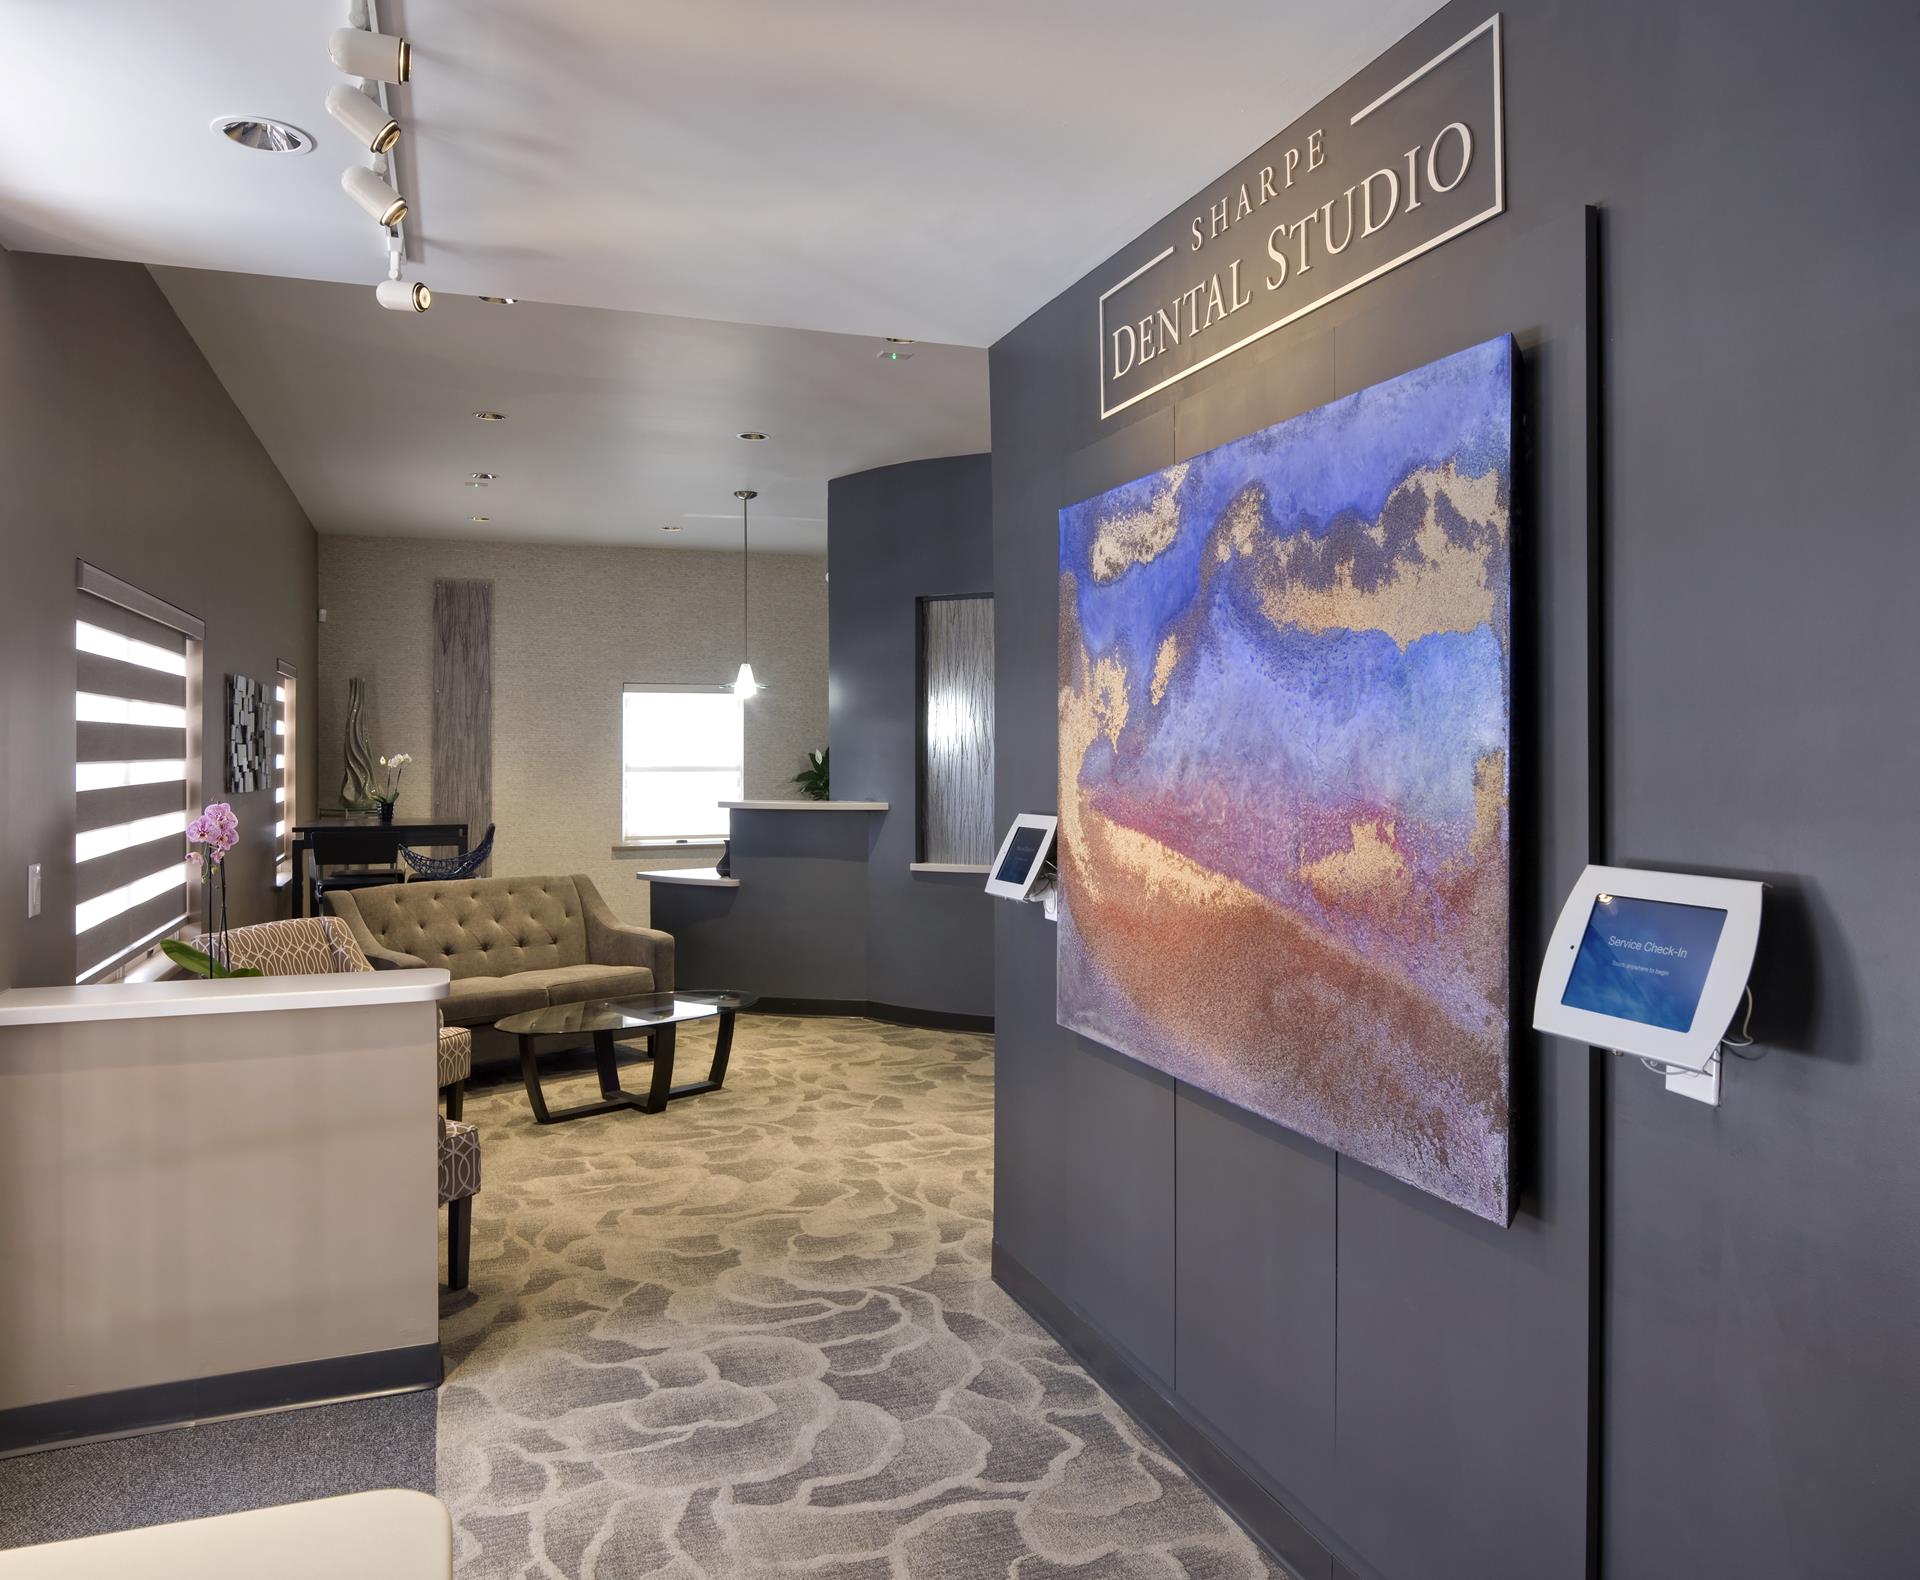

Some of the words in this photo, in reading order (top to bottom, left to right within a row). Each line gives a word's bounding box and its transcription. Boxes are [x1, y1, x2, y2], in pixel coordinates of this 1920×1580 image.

[1113, 259, 1252, 380] DENTAL
[1266, 122, 1474, 290] STUDIO
[1191, 129, 1325, 252] SHARPE
[1608, 935, 1642, 950] Service
[1643, 941, 1688, 959] Check-In
